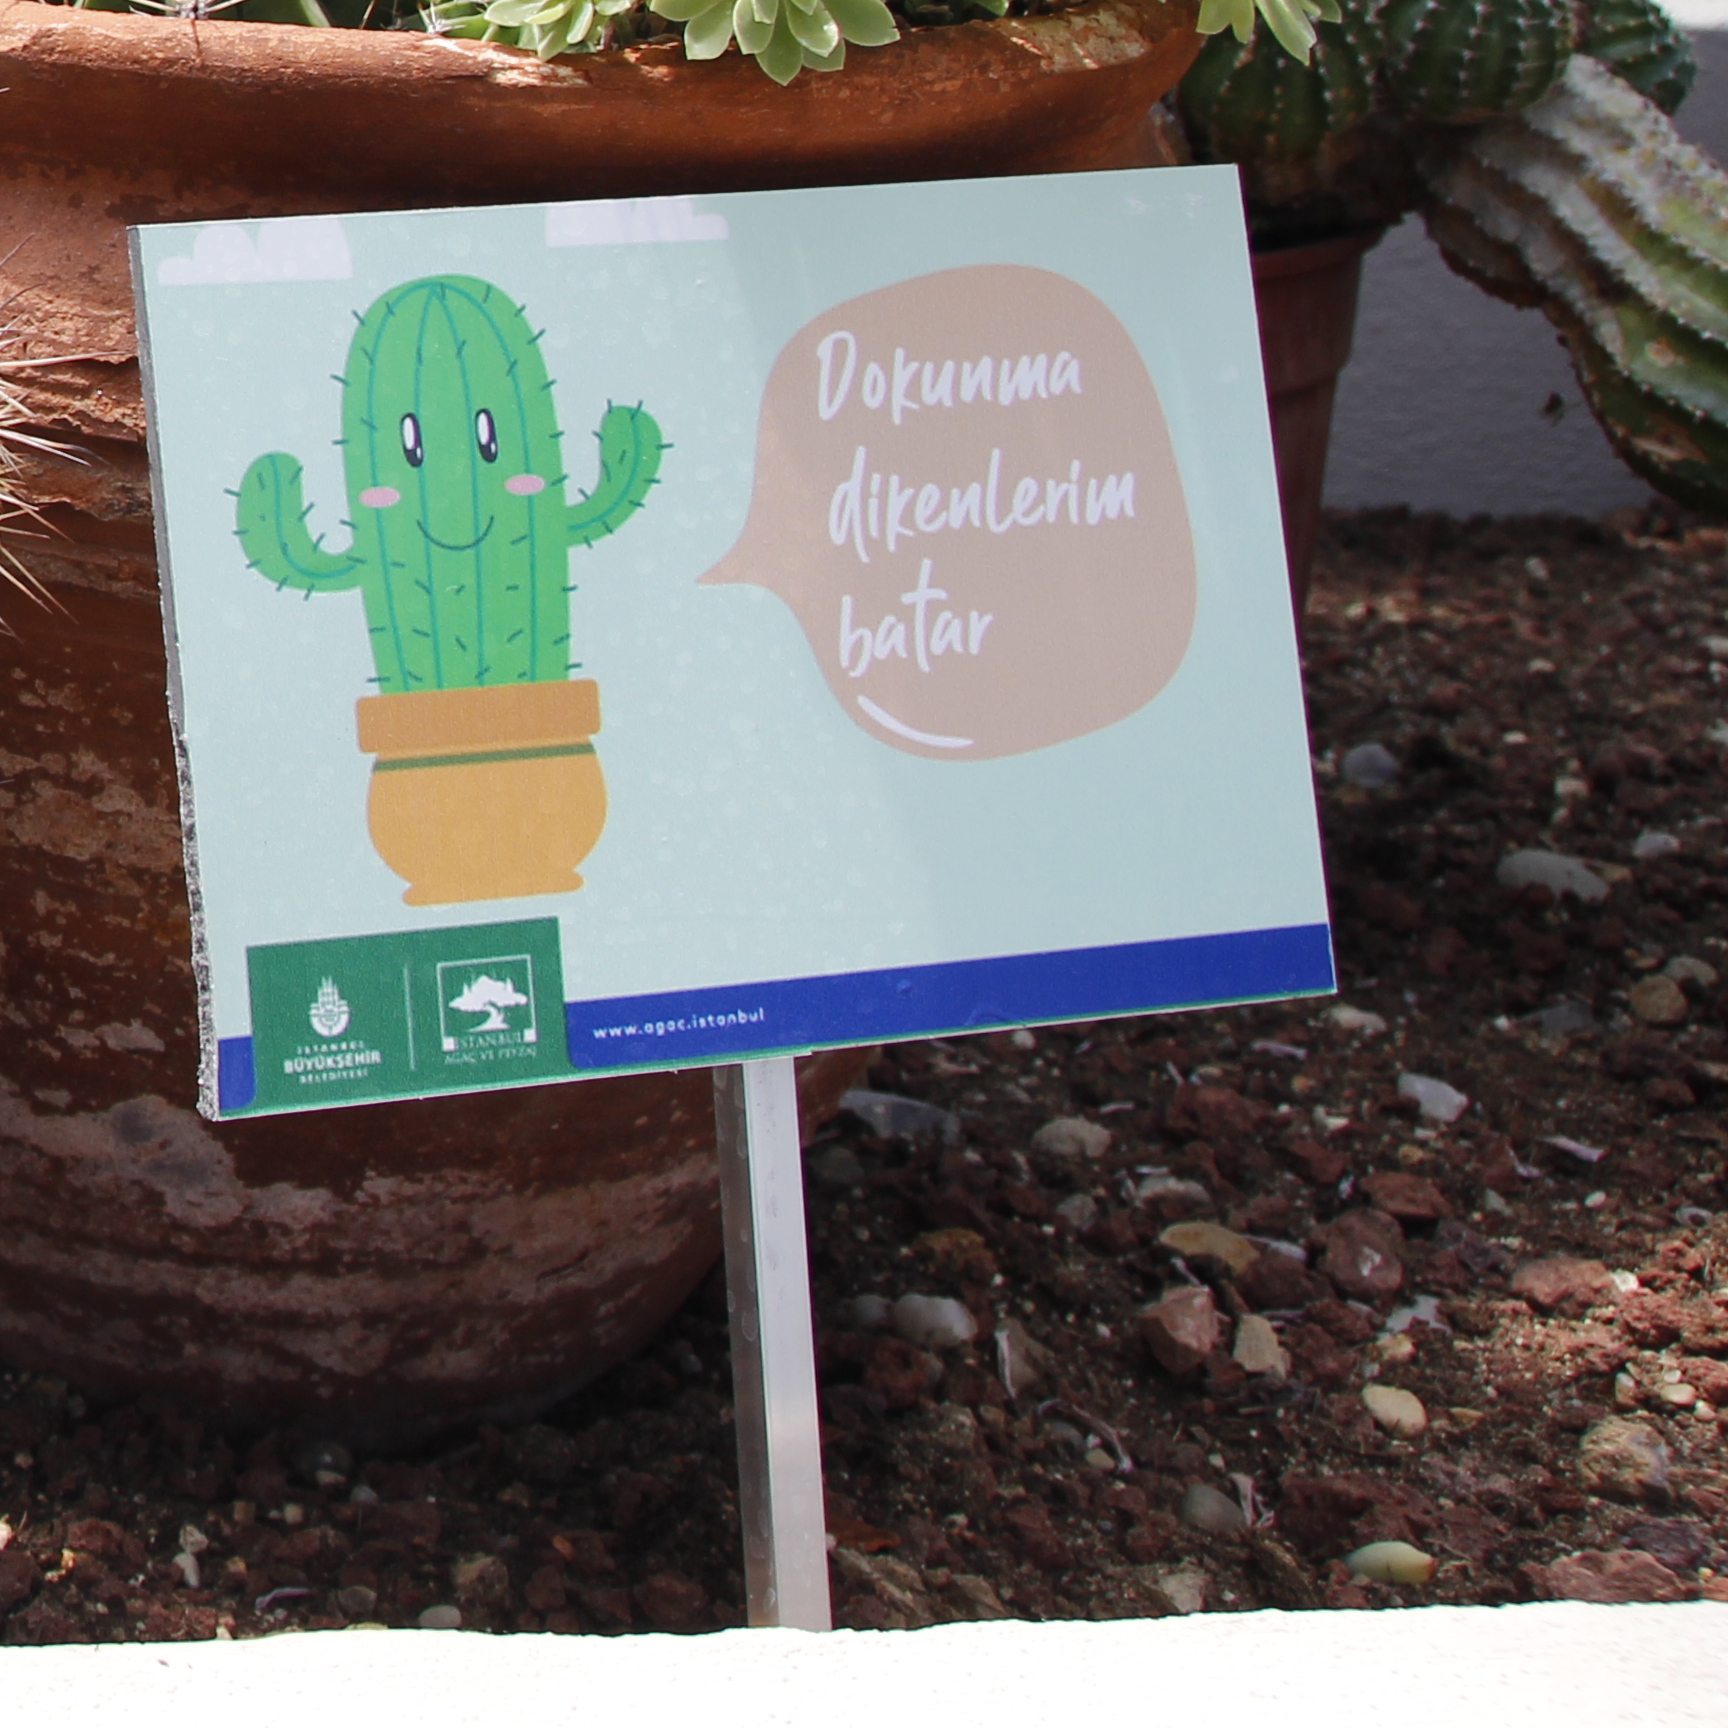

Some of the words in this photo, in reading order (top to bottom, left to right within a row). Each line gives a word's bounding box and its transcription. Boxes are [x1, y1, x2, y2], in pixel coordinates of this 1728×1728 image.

[816, 330, 1082, 425] Dokunma
[828, 445, 1136, 563] dikenlerim
[839, 558, 993, 677] batar
[593, 1006, 765, 1039] www.agac.istanbul
